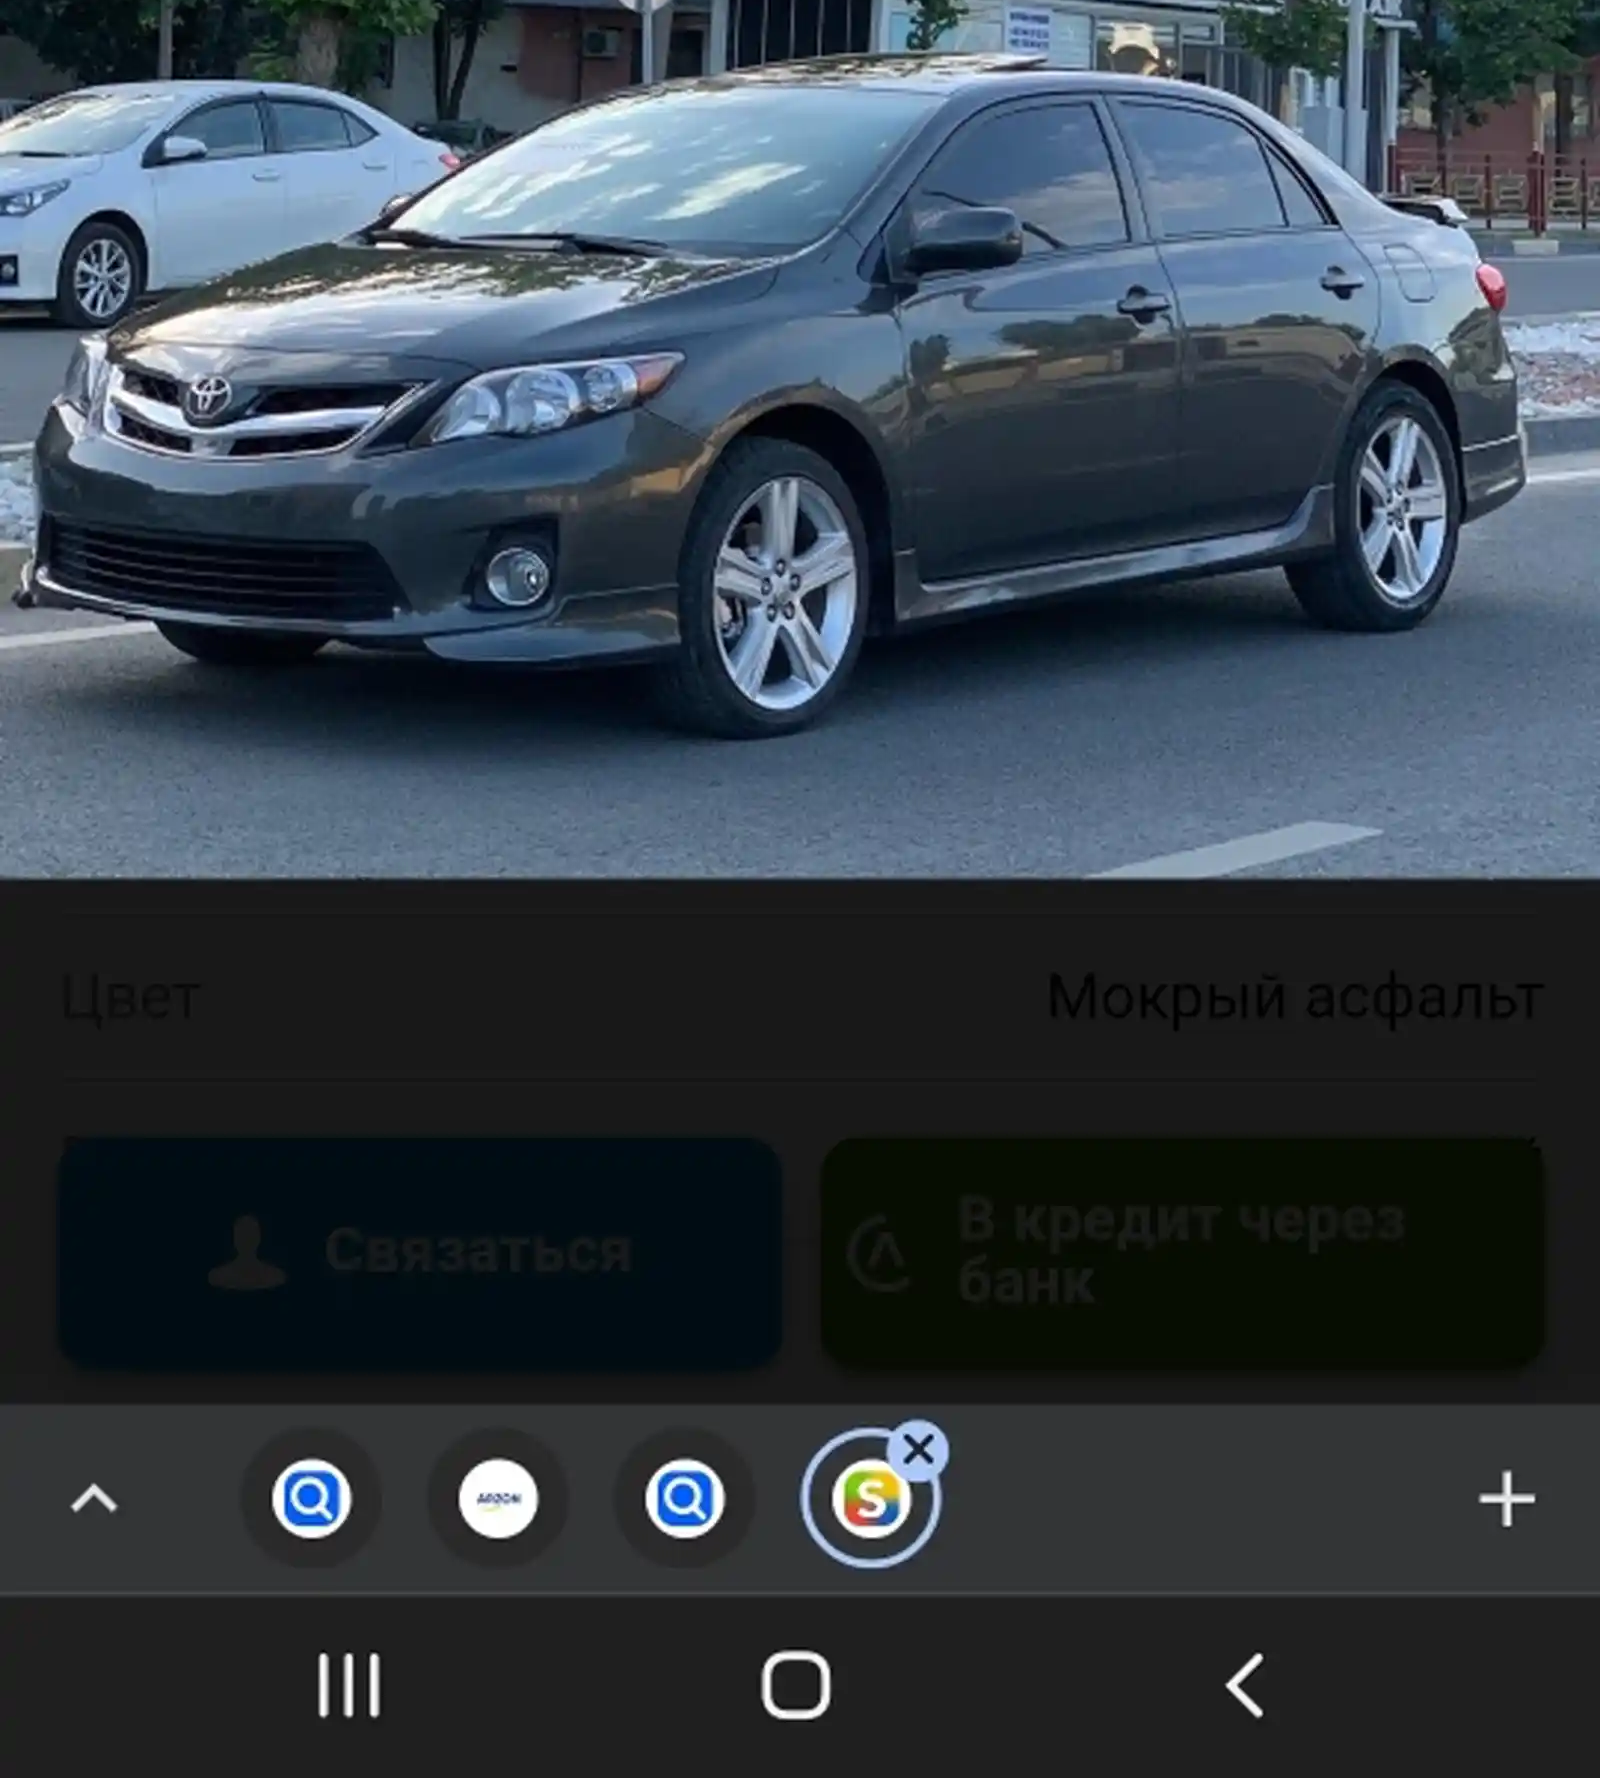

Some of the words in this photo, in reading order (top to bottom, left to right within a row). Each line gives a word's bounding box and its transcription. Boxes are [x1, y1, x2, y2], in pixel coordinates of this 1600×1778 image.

[62, 972, 203, 1031] Цвет
[1048, 972, 1286, 1033] Мокрый
[1305, 969, 1546, 1033] асфальт
[324, 1225, 633, 1273] Связаться
[957, 1195, 995, 1241] В
[1014, 1203, 1223, 1253] кредит
[1239, 1204, 1406, 1253] через
[957, 1253, 1096, 1304] банк
